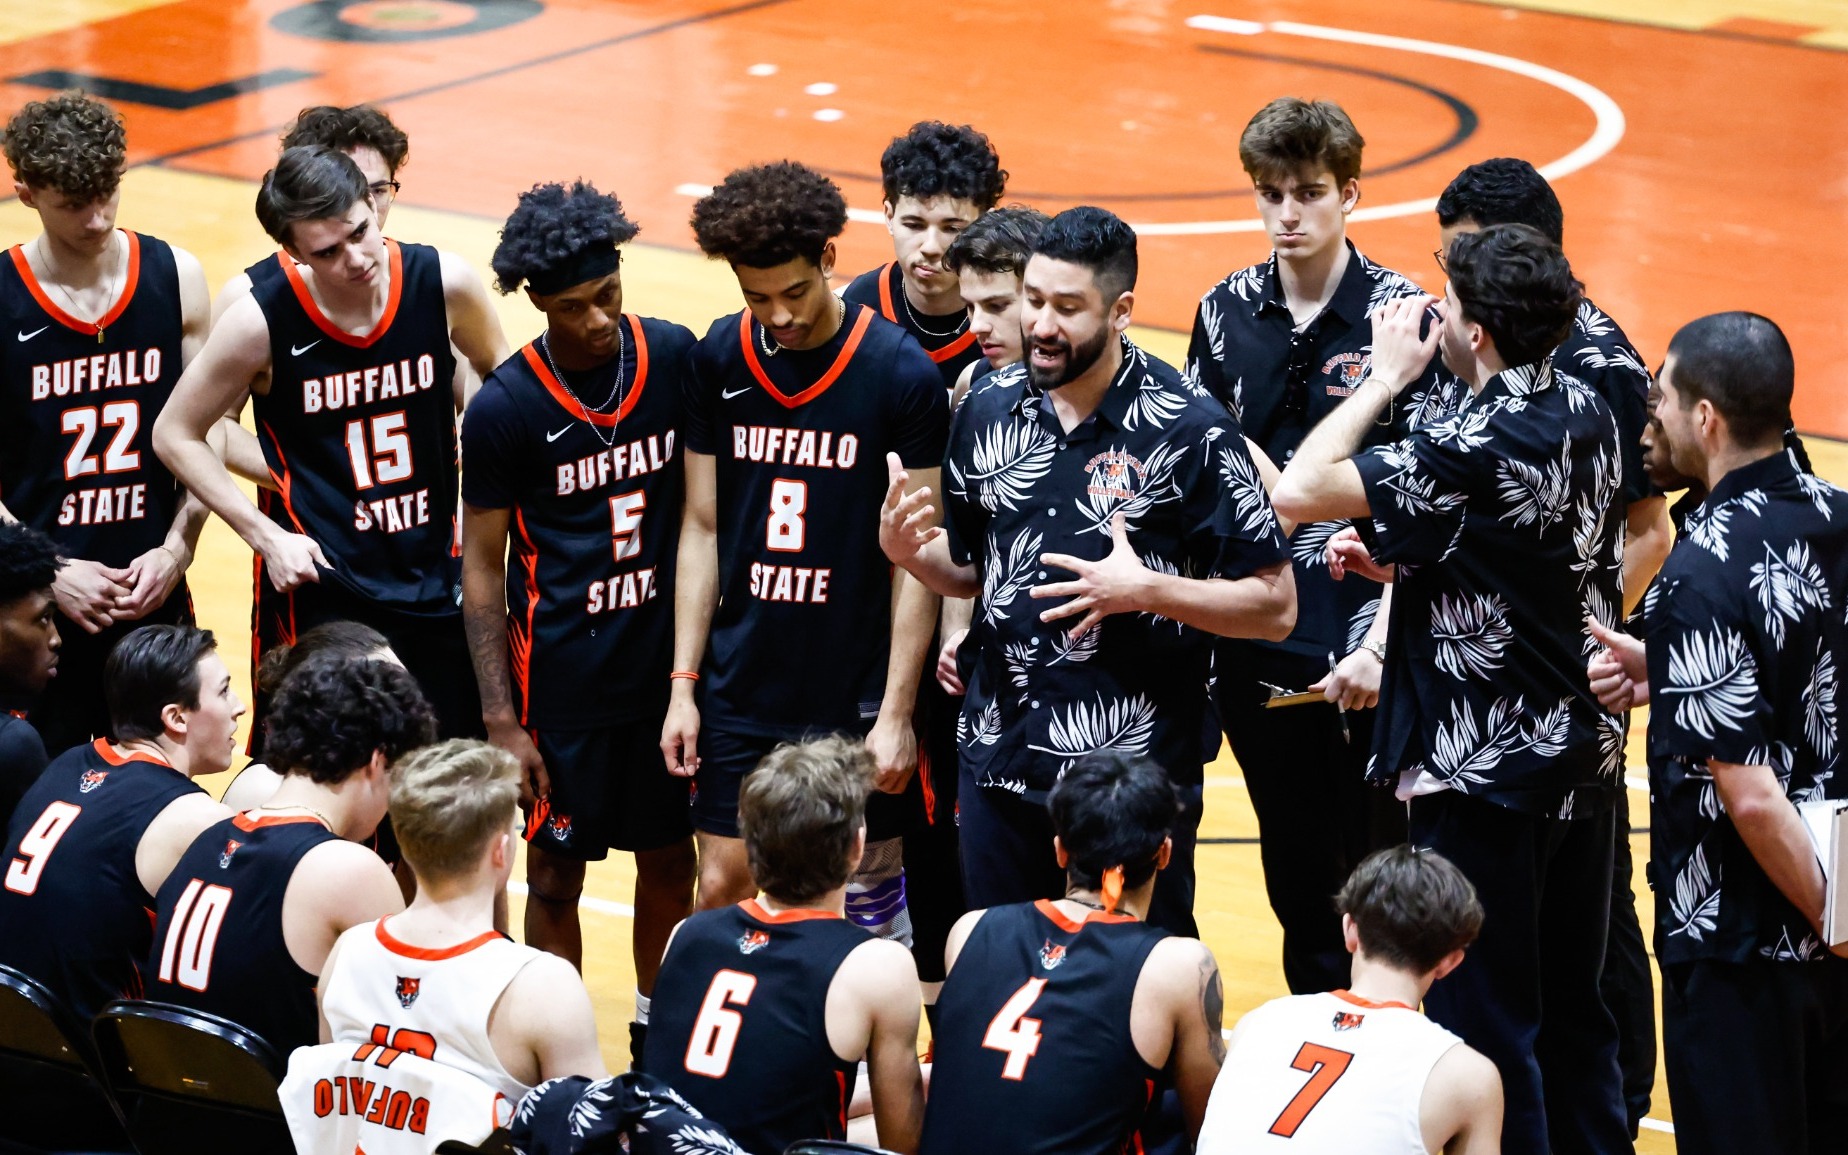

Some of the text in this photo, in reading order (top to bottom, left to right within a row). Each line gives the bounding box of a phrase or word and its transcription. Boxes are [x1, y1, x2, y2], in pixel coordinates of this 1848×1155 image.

[32, 347, 161, 400] BUFFALO
[303, 354, 434, 413] BUFFALO
[1322, 352, 1361, 375] BUFFALO
[60, 400, 141, 480] 22
[344, 410, 413, 491] 15
[556, 429, 676, 496] BUFFALO
[732, 425, 858, 470] BUFFALO
[57, 484, 147, 526] STATE
[354, 489, 429, 533] STATE
[609, 489, 646, 562] 5
[766, 478, 807, 552] 8
[587, 568, 657, 614] STATE
[750, 562, 831, 603] STATE
[4, 800, 82, 896] 9
[158, 878, 233, 993] 10
[684, 969, 758, 1079] 6
[981, 976, 1043, 1081] 4
[1268, 1041, 1355, 1138] 7
